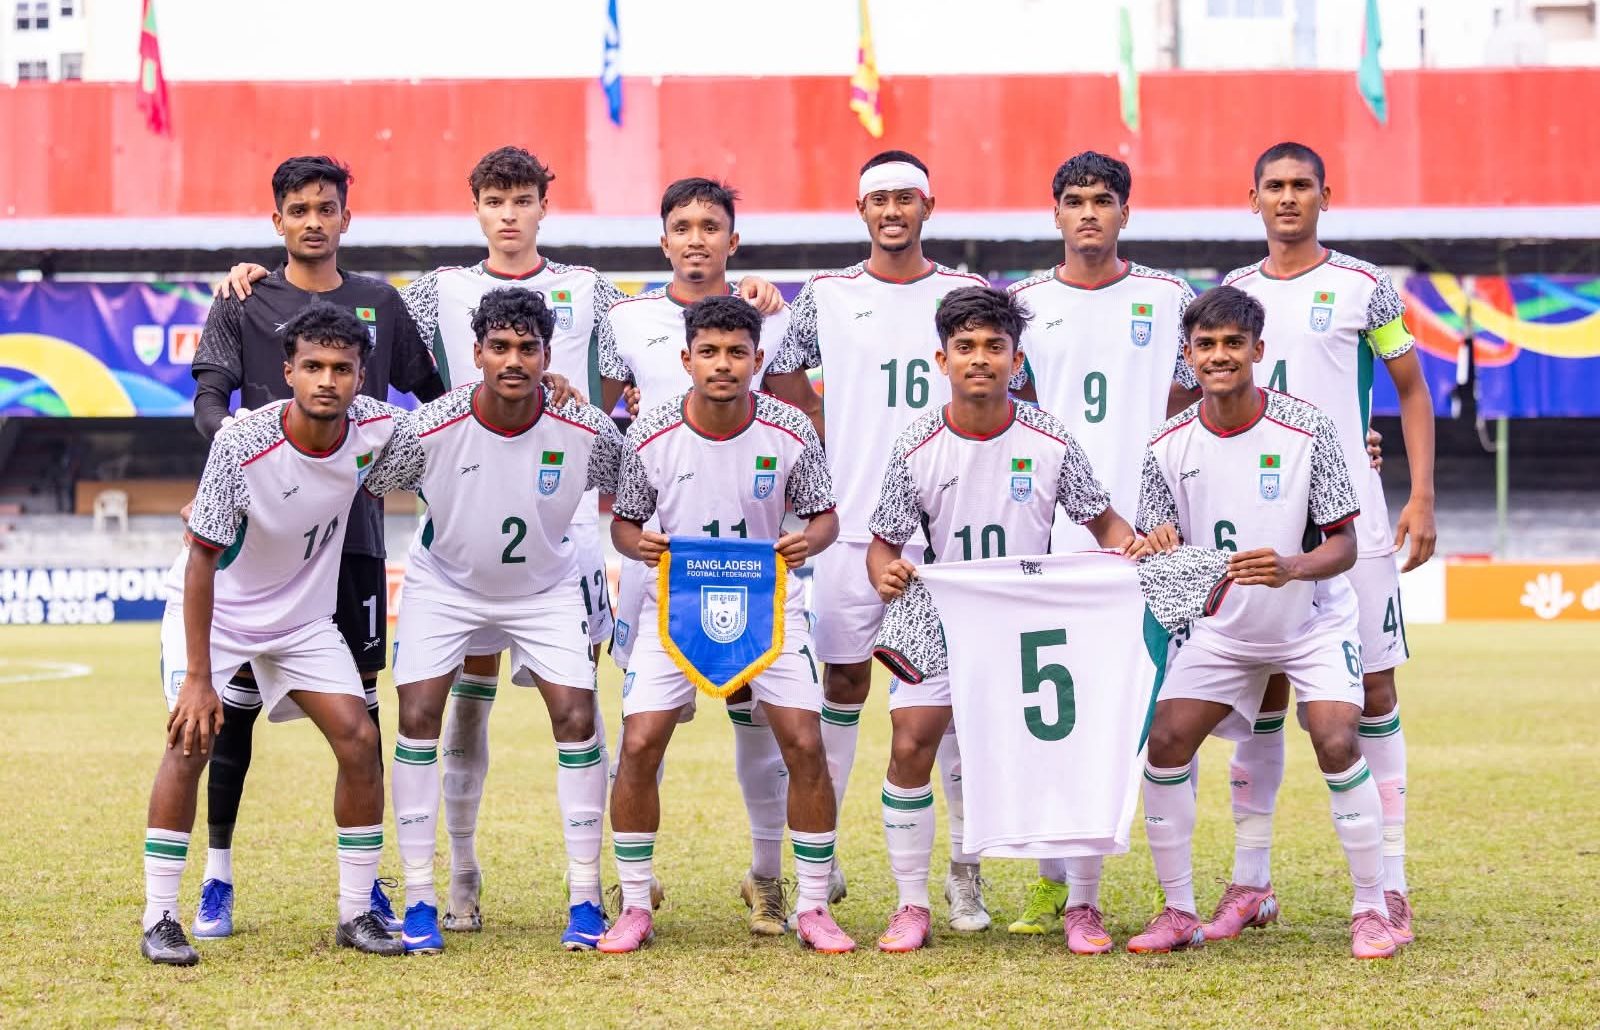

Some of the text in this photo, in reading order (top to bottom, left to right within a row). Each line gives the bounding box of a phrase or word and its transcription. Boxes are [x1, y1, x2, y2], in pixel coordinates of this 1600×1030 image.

[881, 359, 930, 408] 16
[1084, 372, 1107, 423] 9
[501, 516, 527, 564] 2
[954, 524, 1006, 561] 10
[687, 560, 761, 570] BANGLADESH
[580, 569, 606, 615] 12
[363, 595, 376, 638] 1
[1383, 597, 1398, 637] 4
[1342, 641, 1363, 679] 6
[1020, 628, 1076, 741] 5
